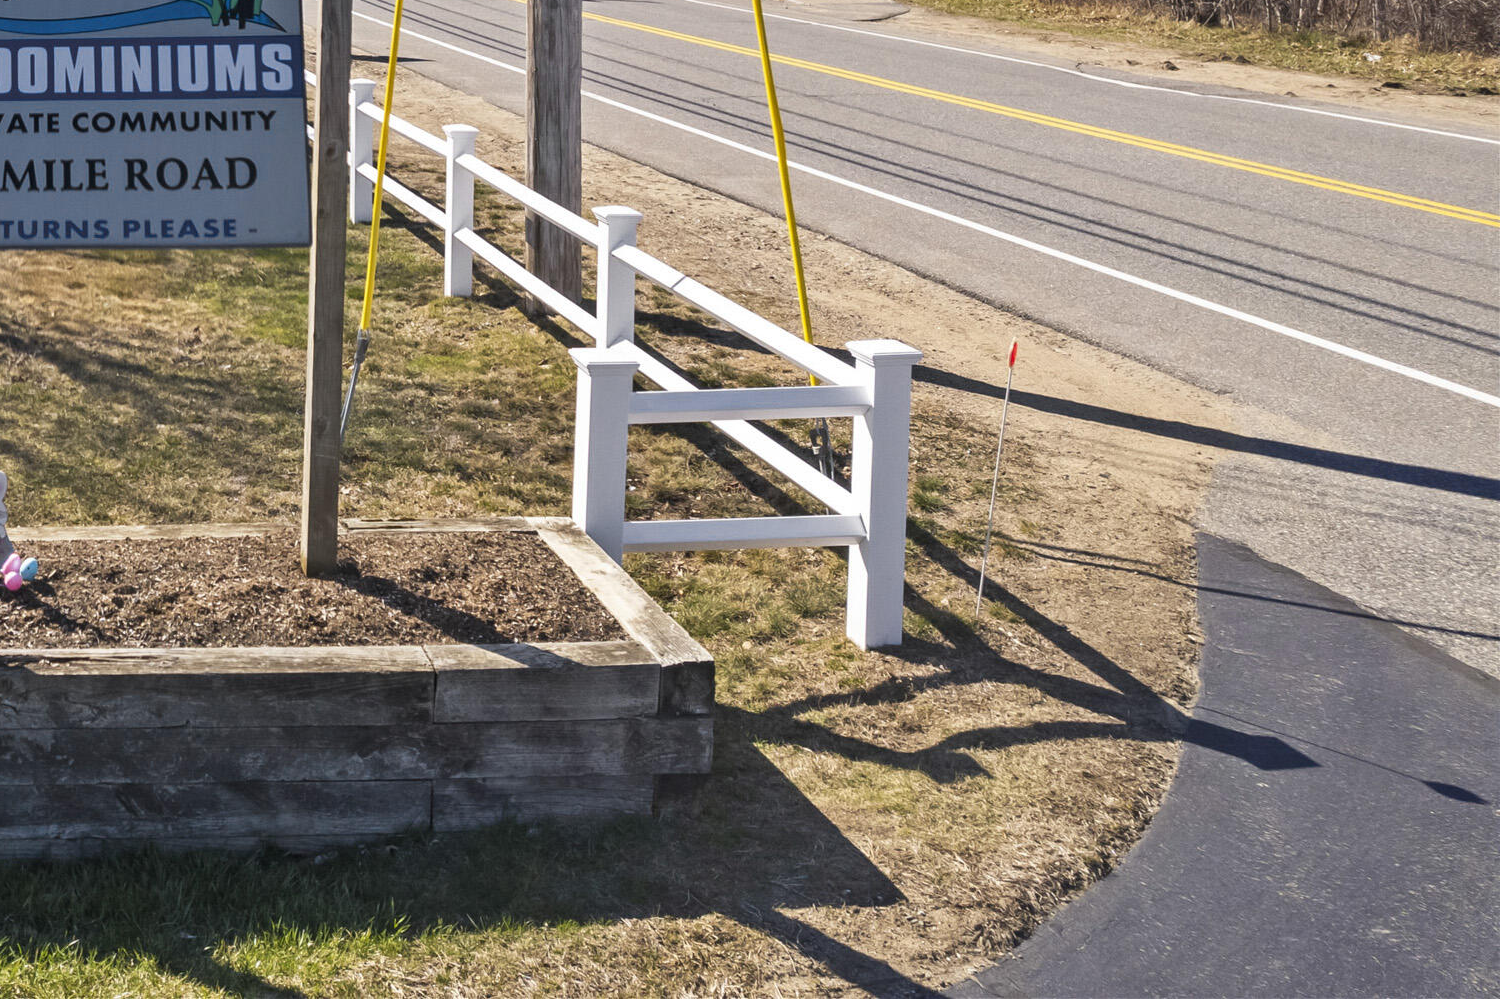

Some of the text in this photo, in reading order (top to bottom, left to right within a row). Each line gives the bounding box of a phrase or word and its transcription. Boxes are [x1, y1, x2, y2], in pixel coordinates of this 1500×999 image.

[72, 110, 277, 133] COMMUNITY
[0, 158, 109, 192] MILE
[125, 156, 258, 191] ROAD
[0, 219, 110, 240] TURNS
[123, 218, 237, 239] PLEASE
